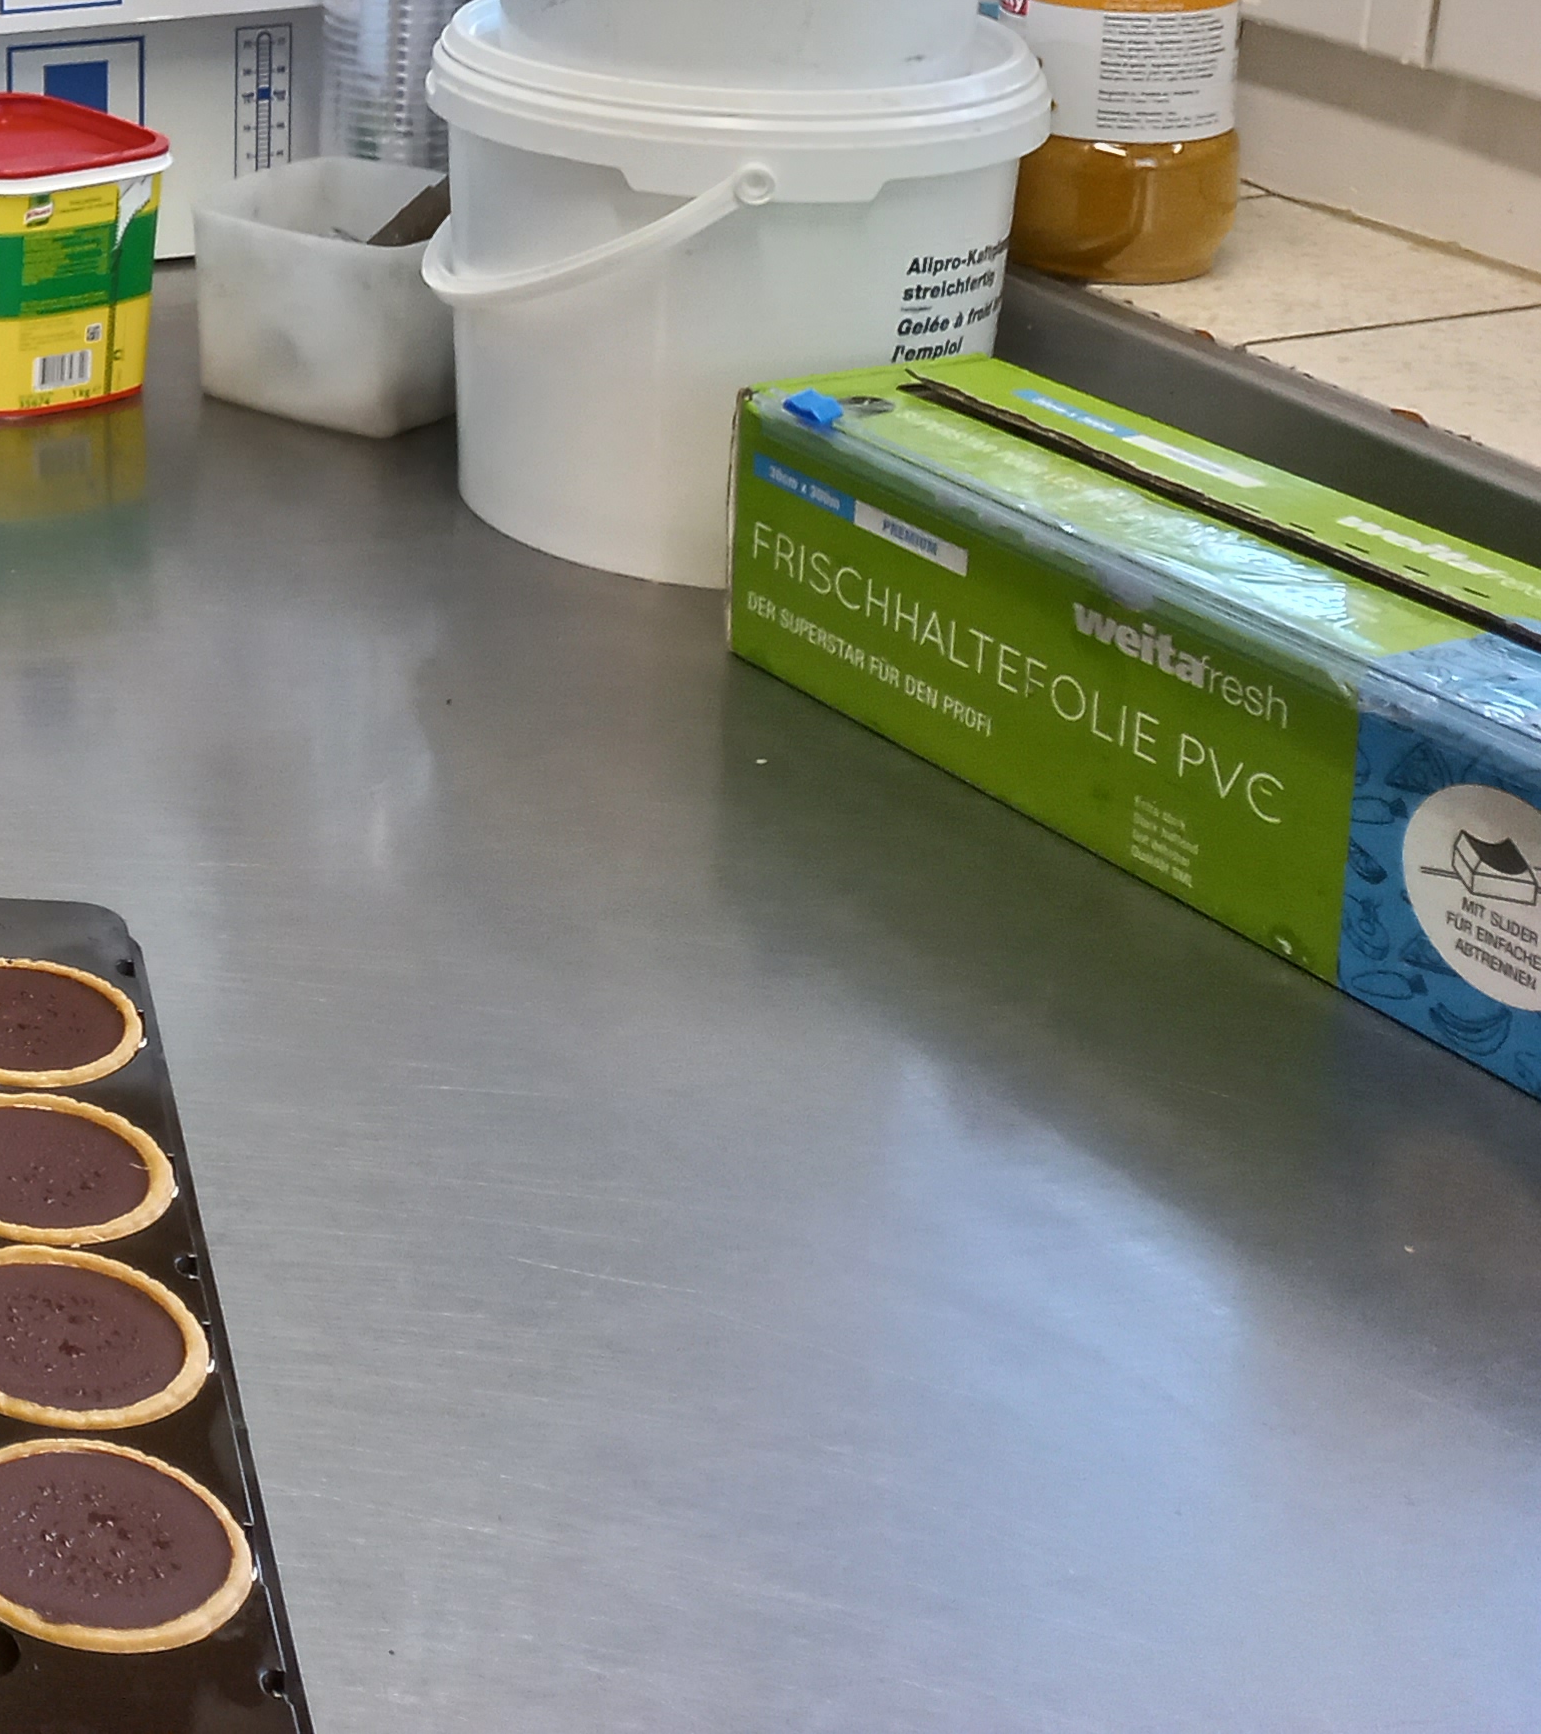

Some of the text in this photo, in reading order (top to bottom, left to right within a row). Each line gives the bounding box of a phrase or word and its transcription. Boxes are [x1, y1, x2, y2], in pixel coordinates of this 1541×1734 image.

[897, 315, 951, 336] Gelée
[882, 518, 938, 556] PREMIUM
[747, 589, 992, 738] DER SUPERSTAR FÜR DEN PROFI
[752, 521, 1285, 824] FRISCHHALTEFOLIE PVC
[1073, 602, 1288, 729] weitafresh
[1445, 910, 1474, 937] FÜR
[1461, 896, 1539, 947] MIT SLIDER
[1455, 937, 1538, 992] ABTRENNEN
